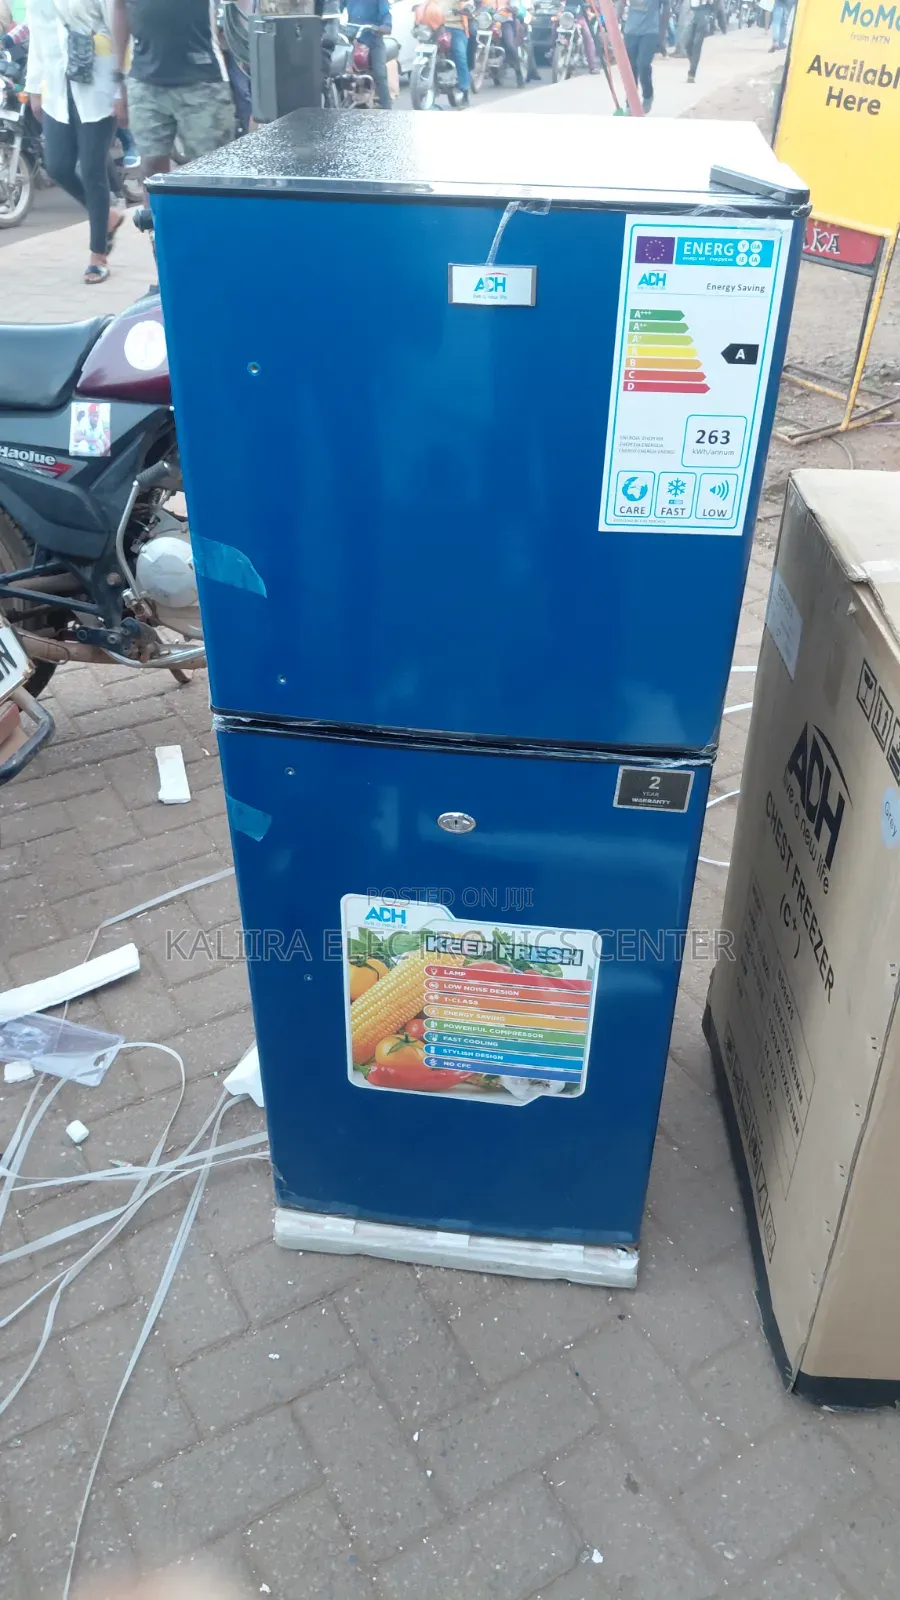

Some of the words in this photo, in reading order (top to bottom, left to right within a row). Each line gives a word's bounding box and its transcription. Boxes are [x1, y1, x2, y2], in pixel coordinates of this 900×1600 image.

[851, 32, 869, 42] from
[872, 35, 890, 44] MTN
[826, 86, 881, 116] Here
[684, 242, 734, 256] ENERG
[473, 276, 506, 292] ADH
[638, 272, 667, 286] ADH
[706, 283, 735, 292] Energy
[737, 284, 765, 293] Saving
[735, 349, 745, 360] A
[627, 382, 635, 390] D
[695, 430, 731, 445] 263
[692, 448, 734, 456] kWh/annum
[620, 506, 646, 514] CARE
[660, 507, 686, 516] FAST
[703, 509, 728, 517] LOW
[648, 776, 661, 790] 2
[632, 797, 671, 805] WARRANTY
[786, 721, 845, 871] ADH
[884, 801, 898, 837] Grey
[800, 818, 817, 862] new
[816, 853, 829, 895] life
[766, 791, 794, 873] CHEST
[790, 864, 835, 1004] FREEZER
[365, 906, 406, 924] ADH
[425, 935, 493, 958] KEEP
[498, 943, 584, 966] FRESH
[443, 969, 466, 977] LAMP
[463, 985, 488, 993] NOISE
[490, 988, 520, 996] DESIGN
[443, 997, 479, 1005] T-CLASS
[443, 1009, 474, 1018] ENERGY
[476, 1013, 506, 1021] SAVING
[443, 1023, 488, 1033] POWERFUL
[489, 1028, 544, 1039] COMPRESSOR
[443, 1035, 461, 1043] FAST
[463, 1038, 499, 1047] COOLING
[443, 1048, 474, 1057] STYLISH
[475, 1052, 504, 1060] DESIGN
